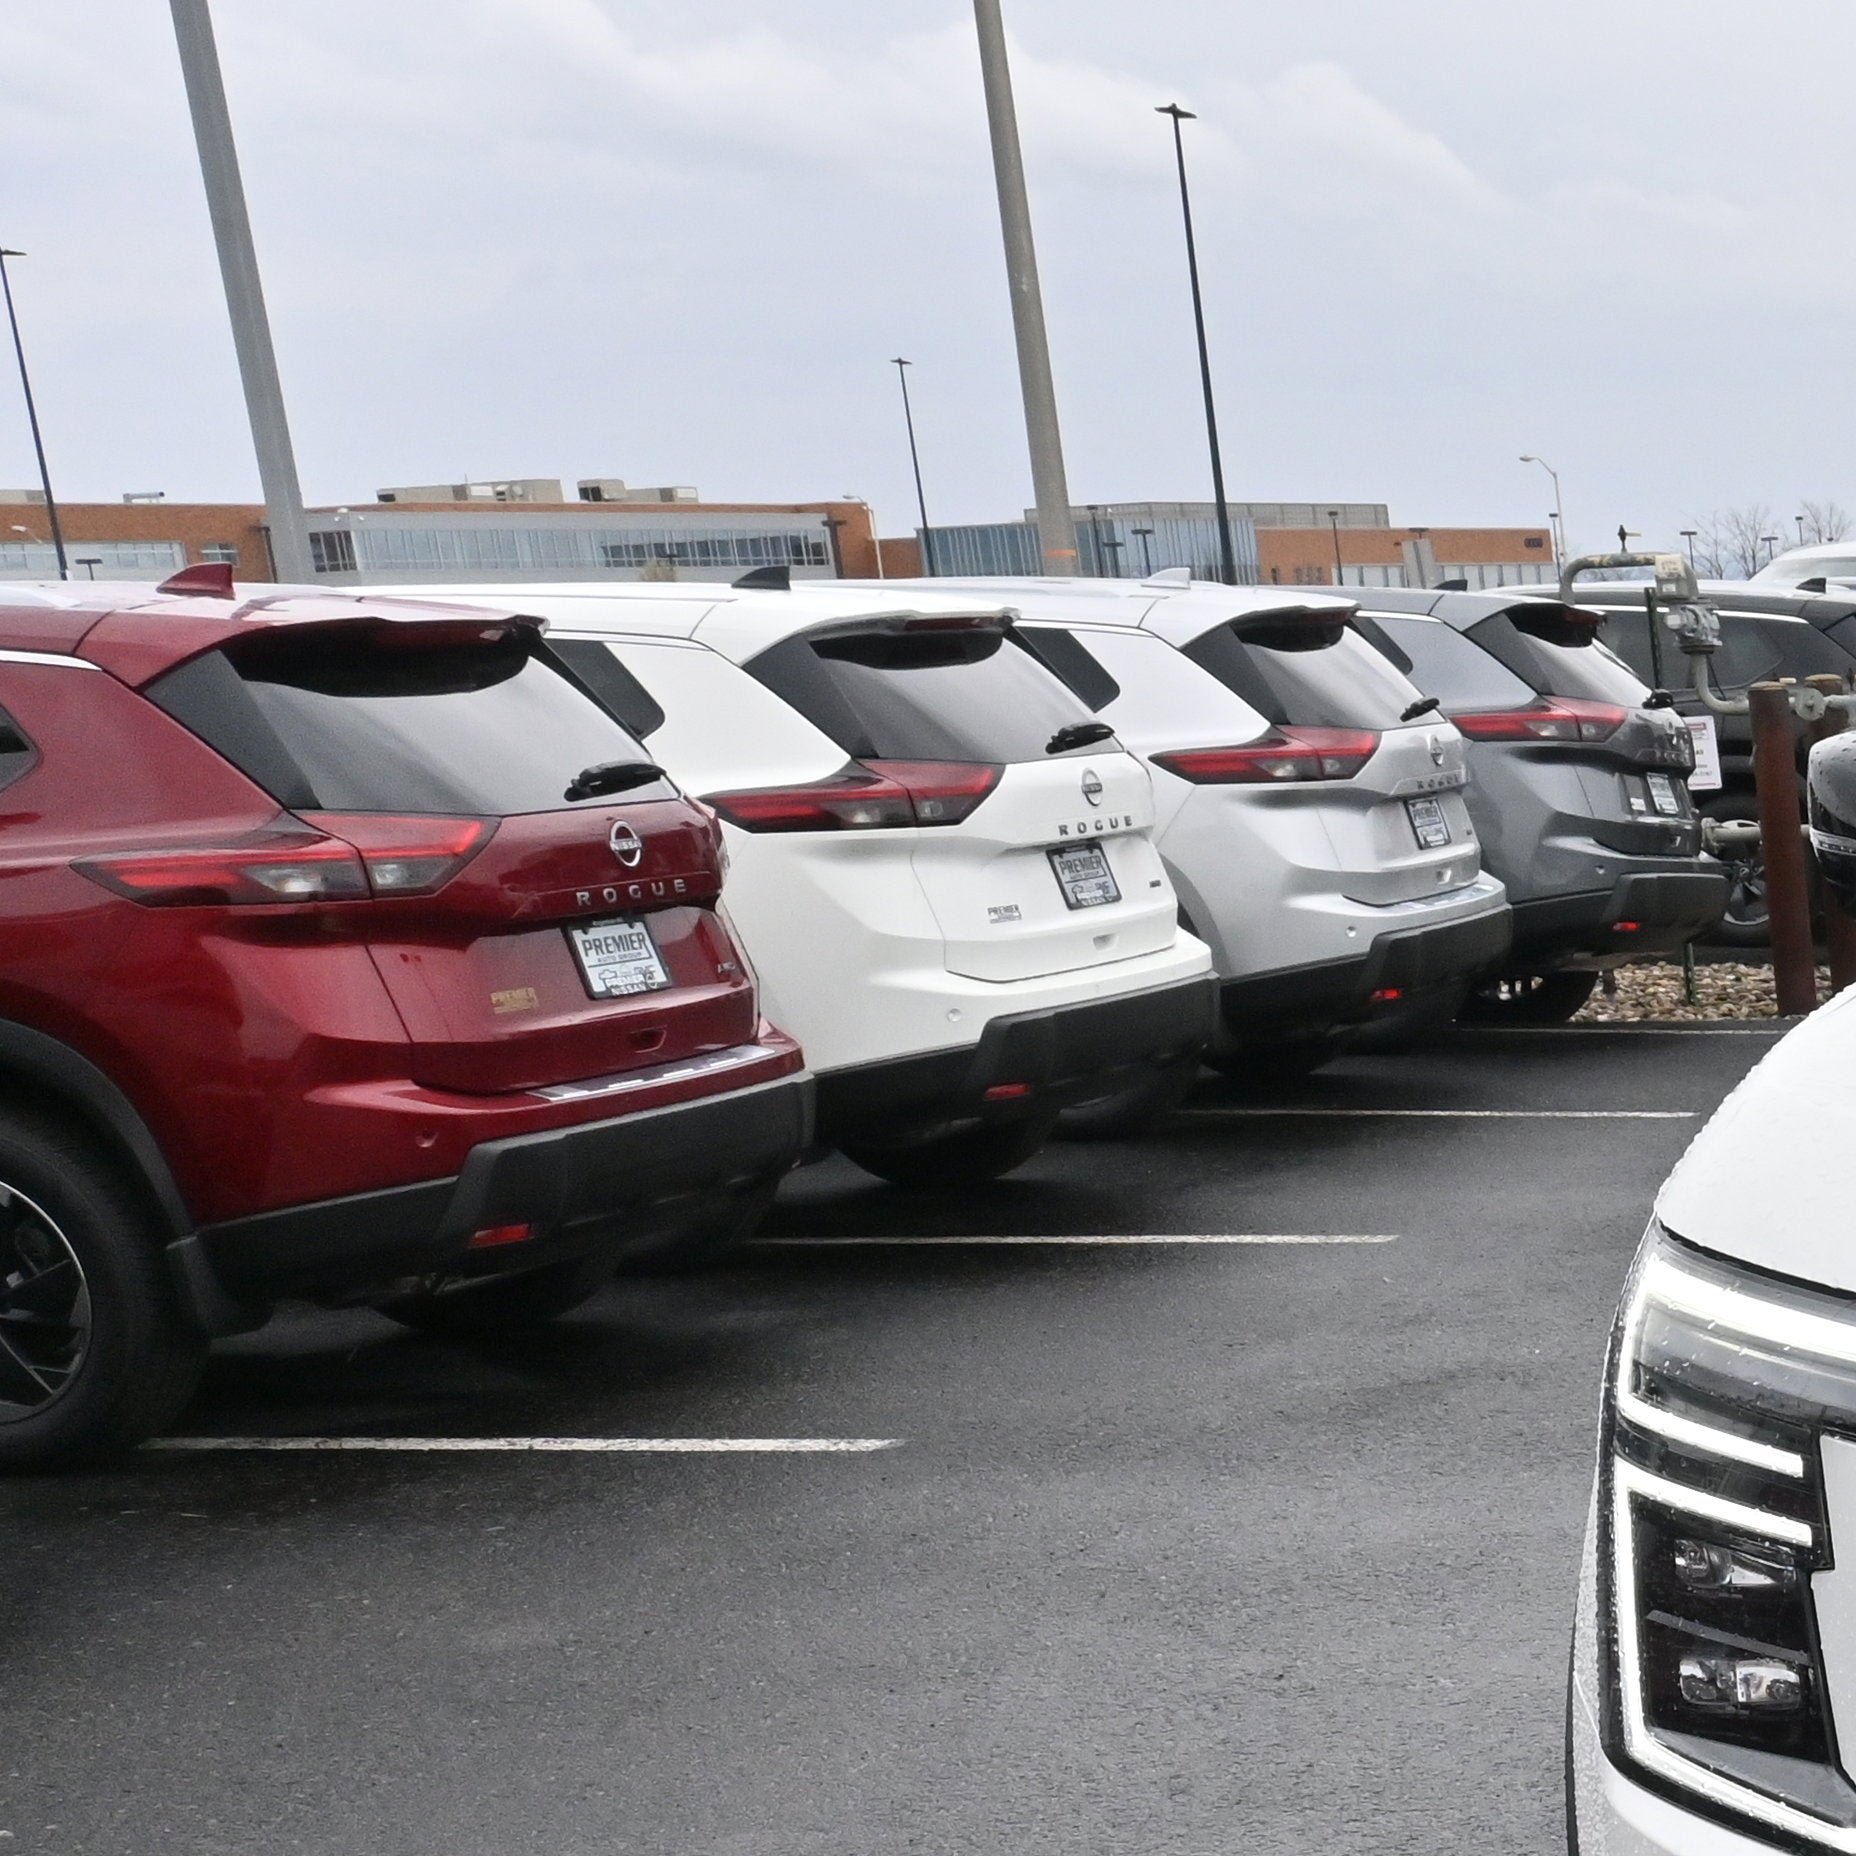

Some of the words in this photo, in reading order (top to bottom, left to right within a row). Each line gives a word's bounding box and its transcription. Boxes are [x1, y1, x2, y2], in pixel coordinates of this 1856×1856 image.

[1058, 815, 1133, 836] ROGUE
[1058, 855, 1102, 875] PREMIER
[576, 878, 687, 907] ROGUE
[581, 932, 646, 957] PREMIER
